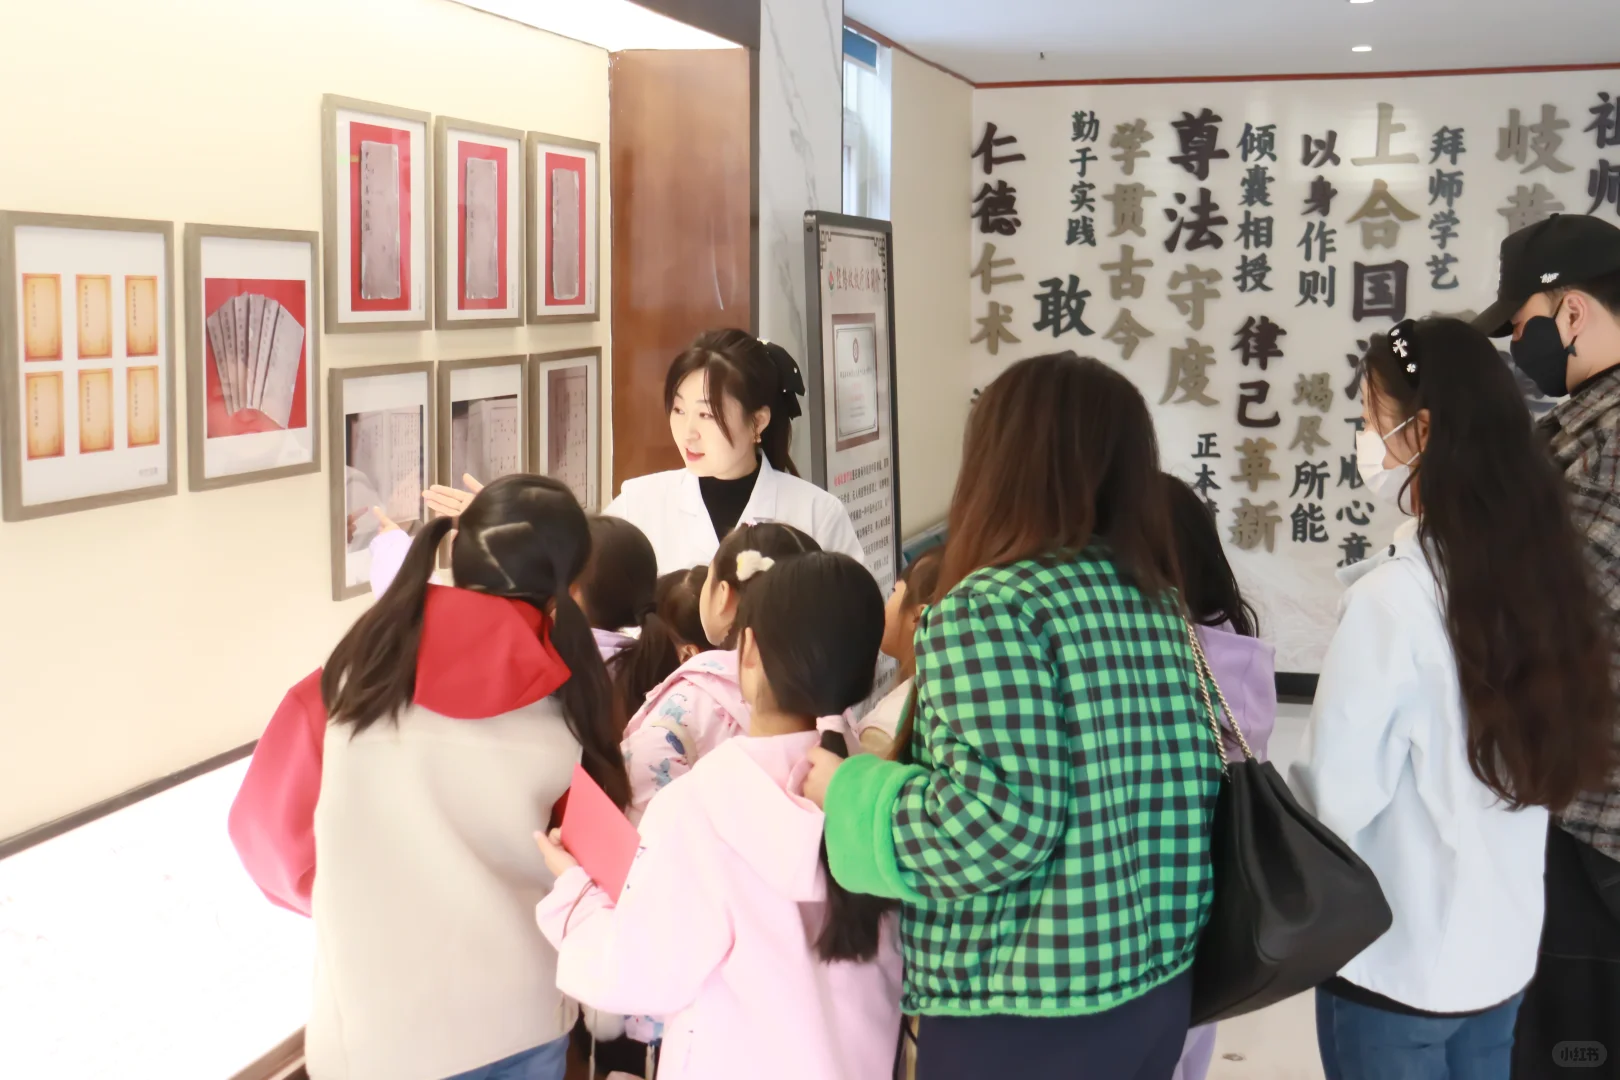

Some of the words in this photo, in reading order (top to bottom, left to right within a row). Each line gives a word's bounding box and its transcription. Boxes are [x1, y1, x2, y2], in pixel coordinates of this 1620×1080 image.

[969, 121, 1027, 356] 仁德仁术
[1065, 110, 1100, 247] 勤于实践
[1099, 117, 1158, 361] 学贯古今
[1158, 107, 1230, 407] 尊法守度
[1232, 122, 1278, 293] 倾囊相授
[1295, 129, 1341, 308] 以身作则
[1425, 125, 1467, 290] 拜师学艺
[1032, 274, 1096, 339] 敢
[1191, 432, 1221, 513] 正本
[1227, 315, 1288, 553] 律己革新
[1289, 371, 1334, 544] 竭尽所能
